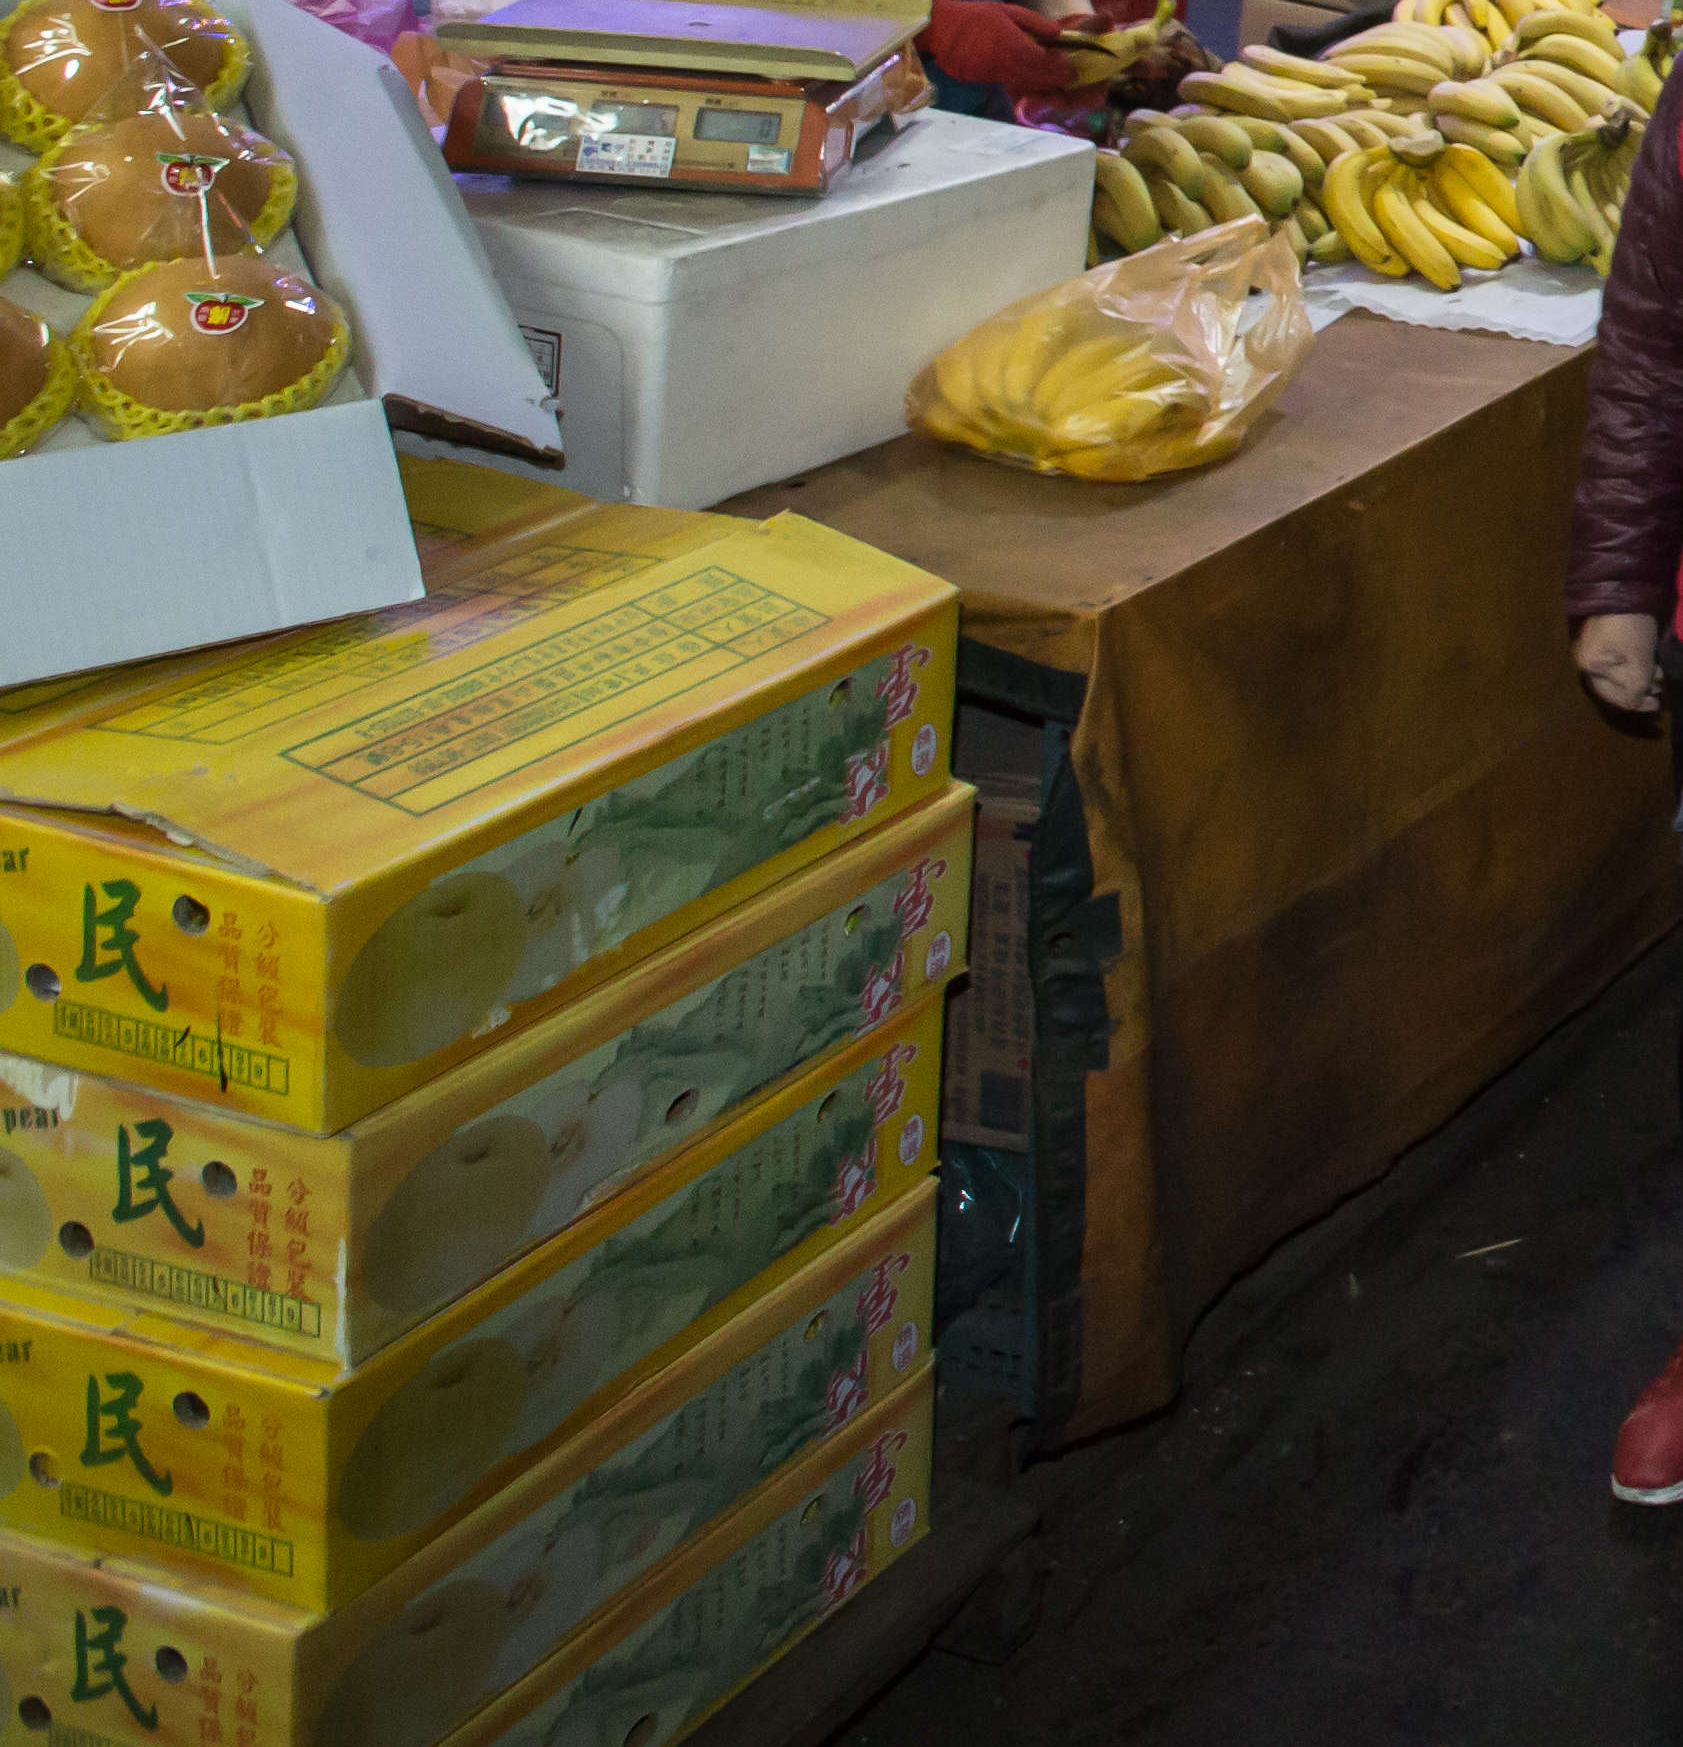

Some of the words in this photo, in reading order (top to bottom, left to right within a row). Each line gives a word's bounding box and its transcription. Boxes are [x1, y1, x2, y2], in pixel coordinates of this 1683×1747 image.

[74, 879, 170, 1012] 民
[2, 1107, 60, 1134] pear
[112, 1118, 205, 1248] 民
[79, 1371, 173, 1496] 民
[71, 1605, 159, 1732] 民
